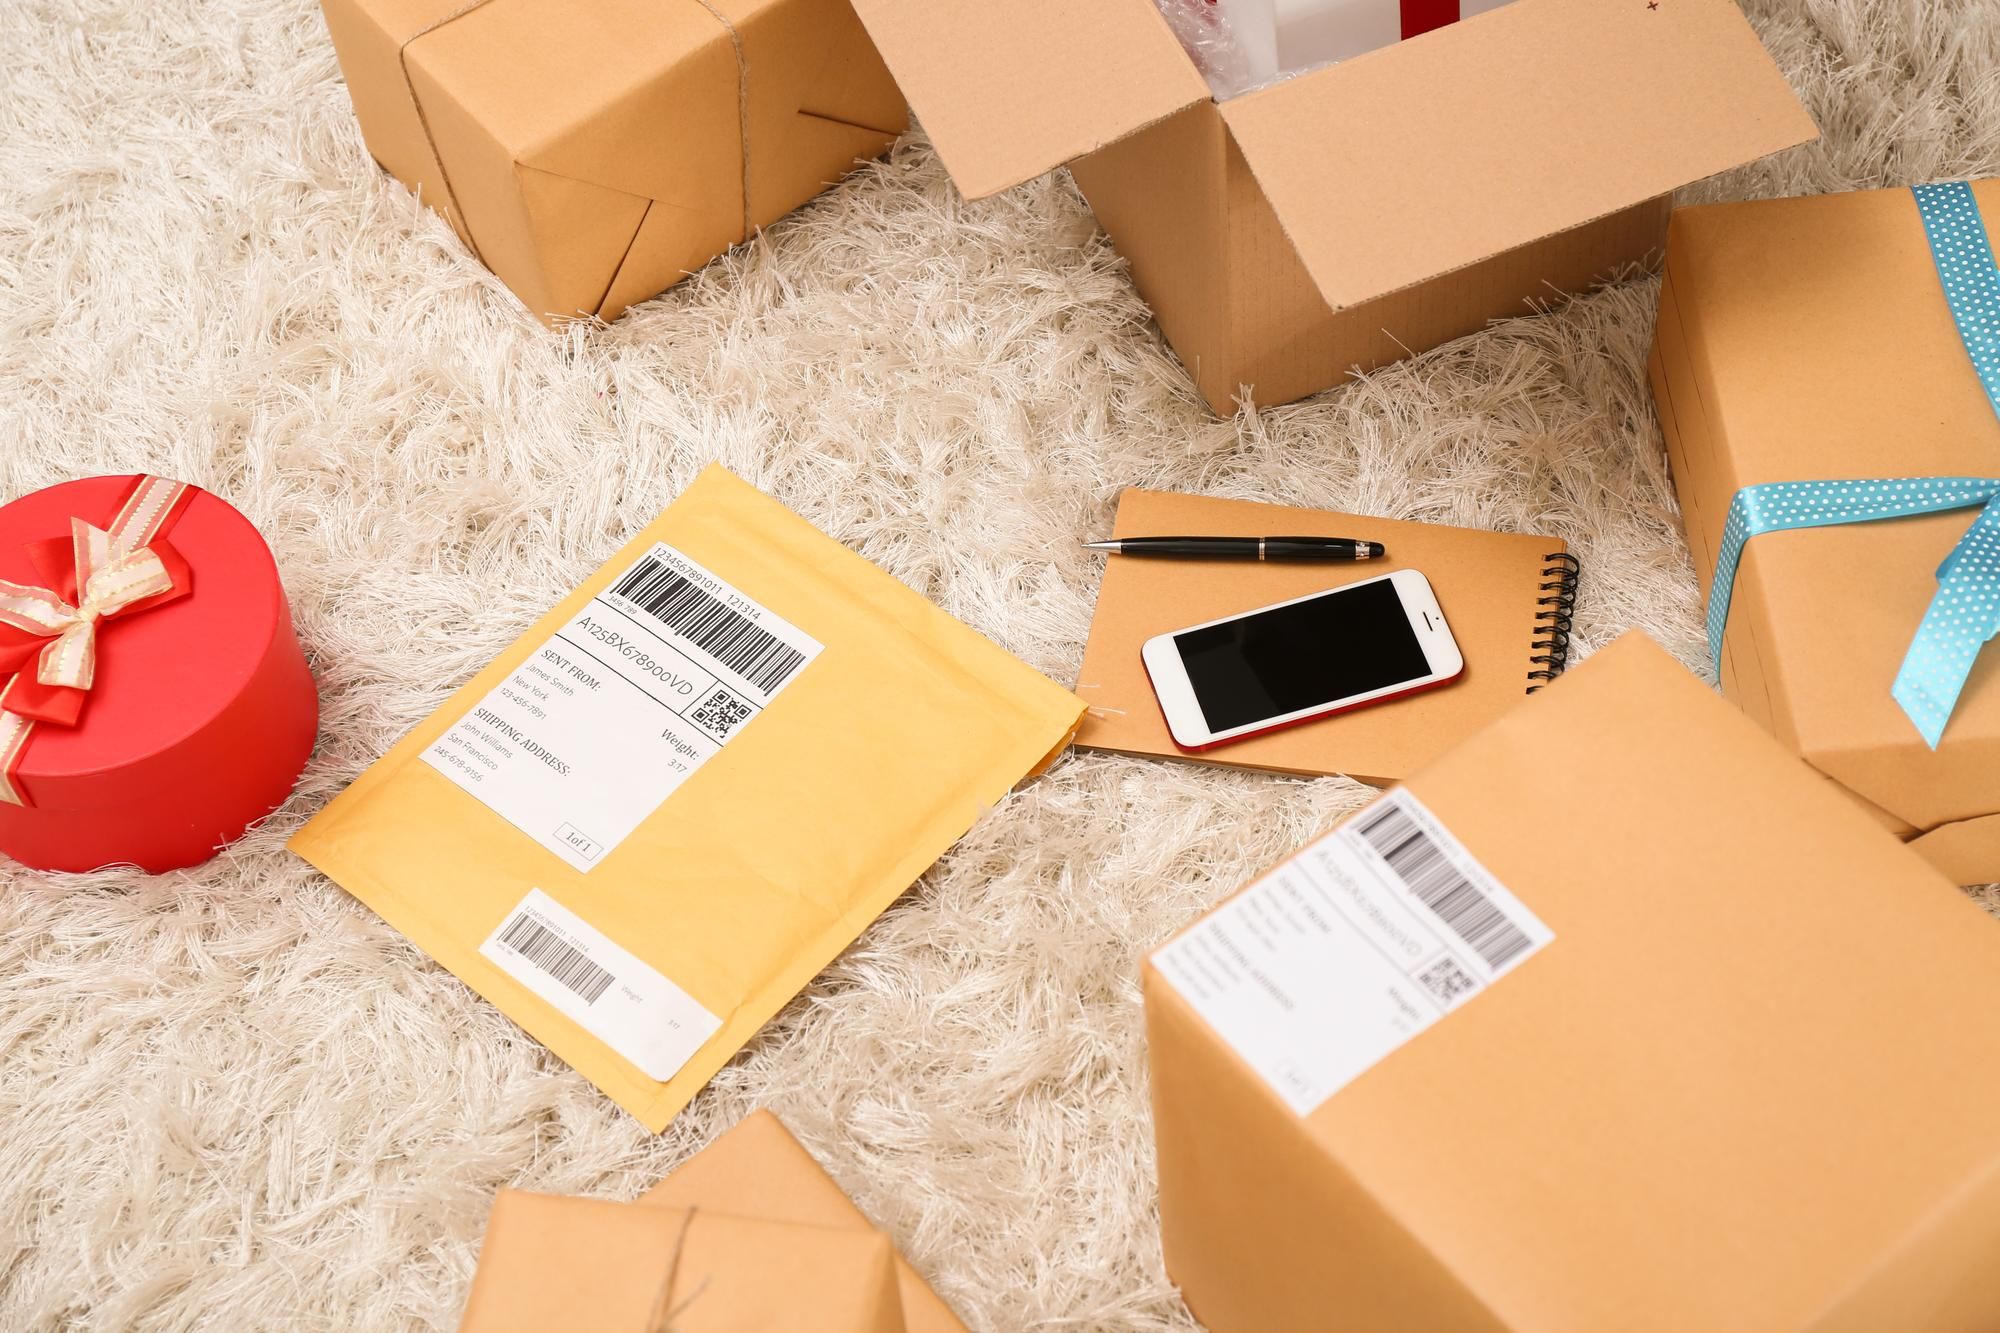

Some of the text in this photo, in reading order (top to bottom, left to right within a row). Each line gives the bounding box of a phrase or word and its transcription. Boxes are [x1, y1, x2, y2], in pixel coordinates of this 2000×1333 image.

[727, 595, 760, 620] 121314
[541, 650, 600, 691] SENT FROM:
[576, 617, 693, 694] A125BX678900VD
[513, 675, 549, 701] New York
[526, 664, 573, 696] James Smith
[501, 688, 546, 719] 123-456-7891
[448, 733, 498, 770] San Francisco
[460, 722, 512, 758] John Williams
[474, 708, 570, 776] SHIPPING ADDRESS:
[661, 729, 699, 760] Weight:
[434, 746, 484, 782] 245-678-9156
